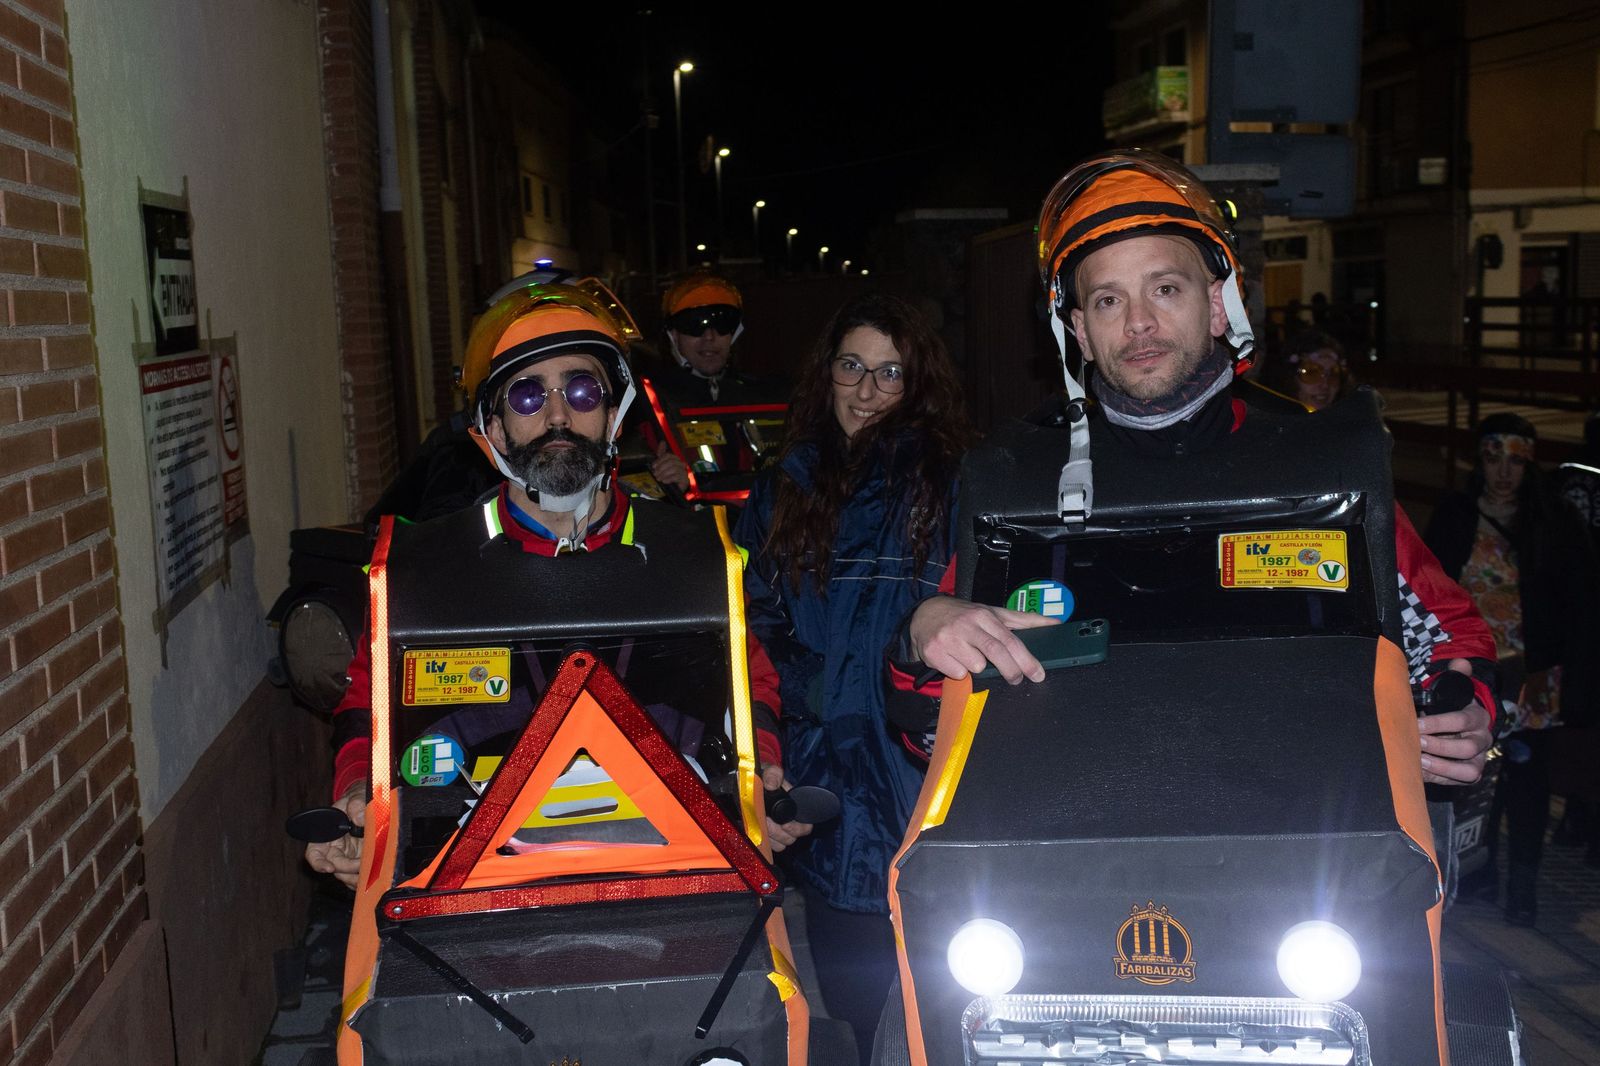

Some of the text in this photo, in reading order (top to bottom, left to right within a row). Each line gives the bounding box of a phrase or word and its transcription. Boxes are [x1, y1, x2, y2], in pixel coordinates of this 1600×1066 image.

[160, 274, 196, 317] ENTRADA
[1246, 543, 1271, 555] itv
[1260, 557, 1291, 566] 1987
[1267, 569, 1278, 577] 12
[1286, 569, 1309, 577] 1987
[1322, 564, 1340, 580] V
[426, 660, 447, 673] itv
[438, 675, 463, 683] 1987
[489, 680, 504, 695] V
[421, 745, 430, 773] ECO
[1120, 962, 1191, 977] FARIBALIZAS
